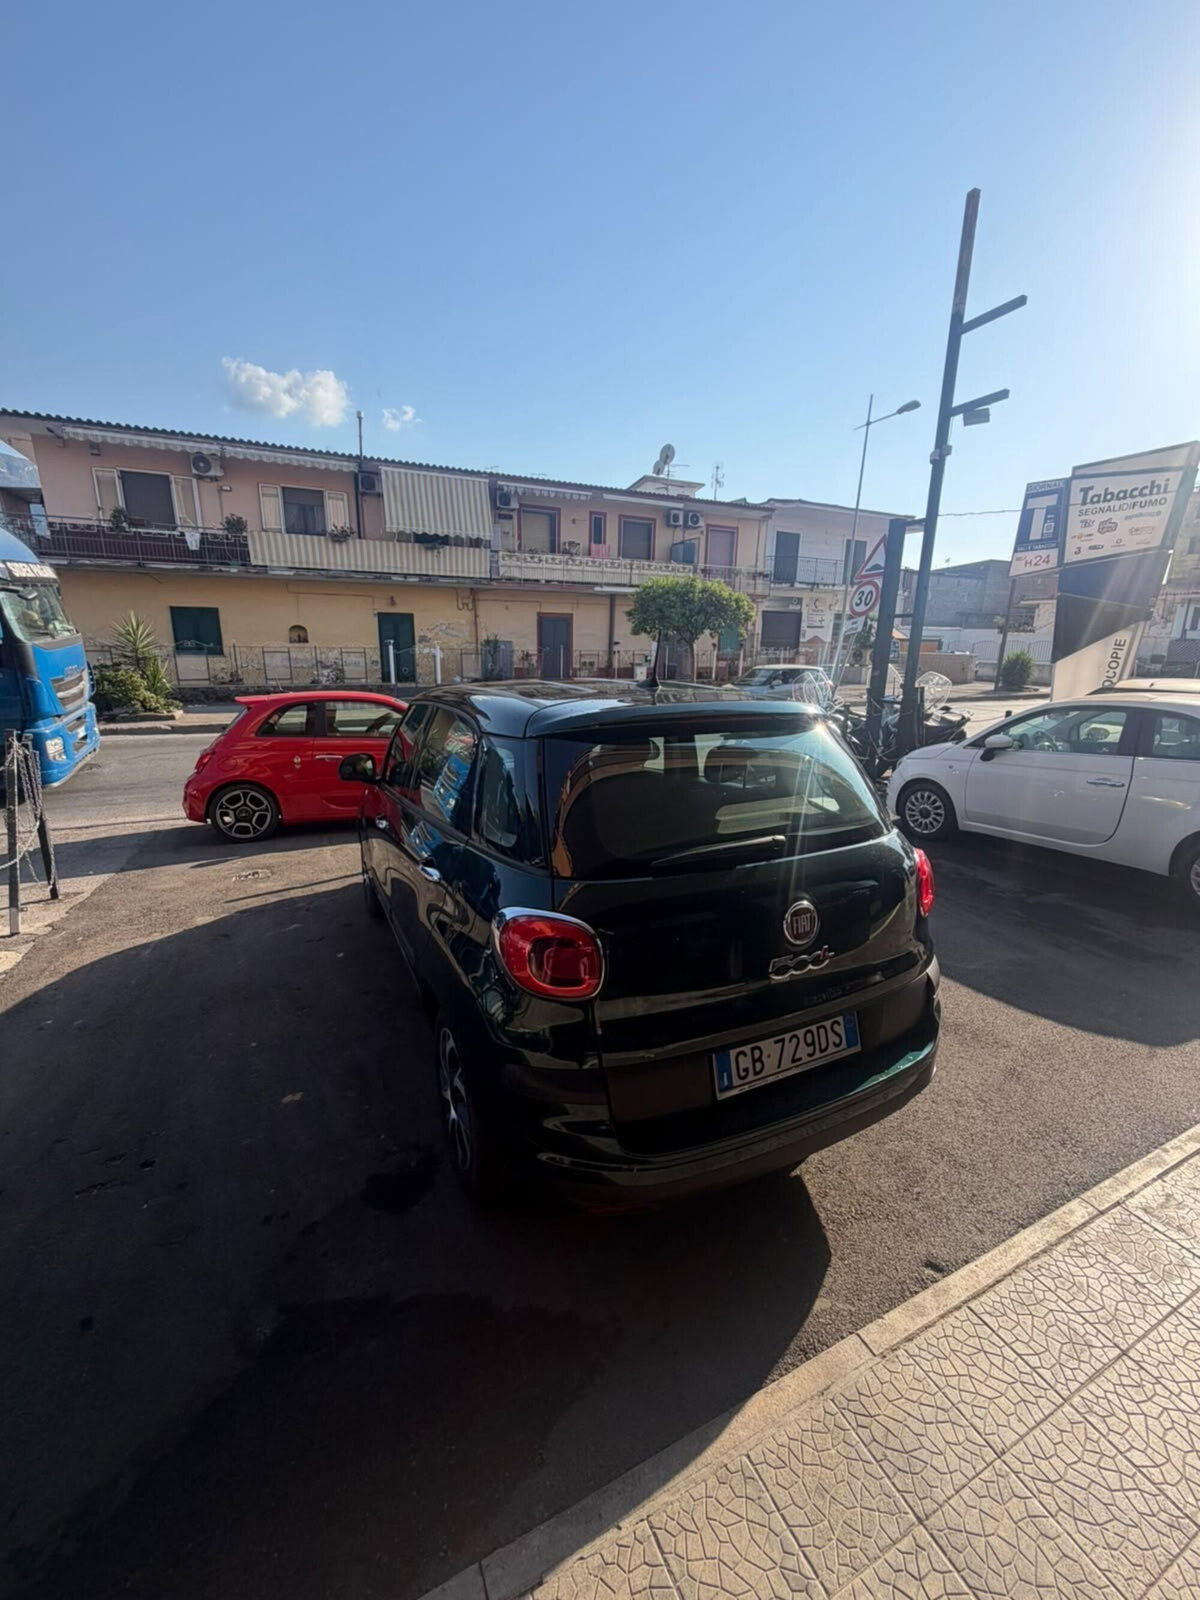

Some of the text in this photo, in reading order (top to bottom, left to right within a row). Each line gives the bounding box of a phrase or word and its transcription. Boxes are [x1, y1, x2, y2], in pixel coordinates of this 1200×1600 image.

[1080, 478, 1170, 506] Tabacchi
[1024, 553, 1051, 568] H24
[855, 590, 873, 607] 30
[793, 913, 811, 935] FIAT
[735, 1045, 764, 1081] GB
[774, 1020, 843, 1069] 729DS
